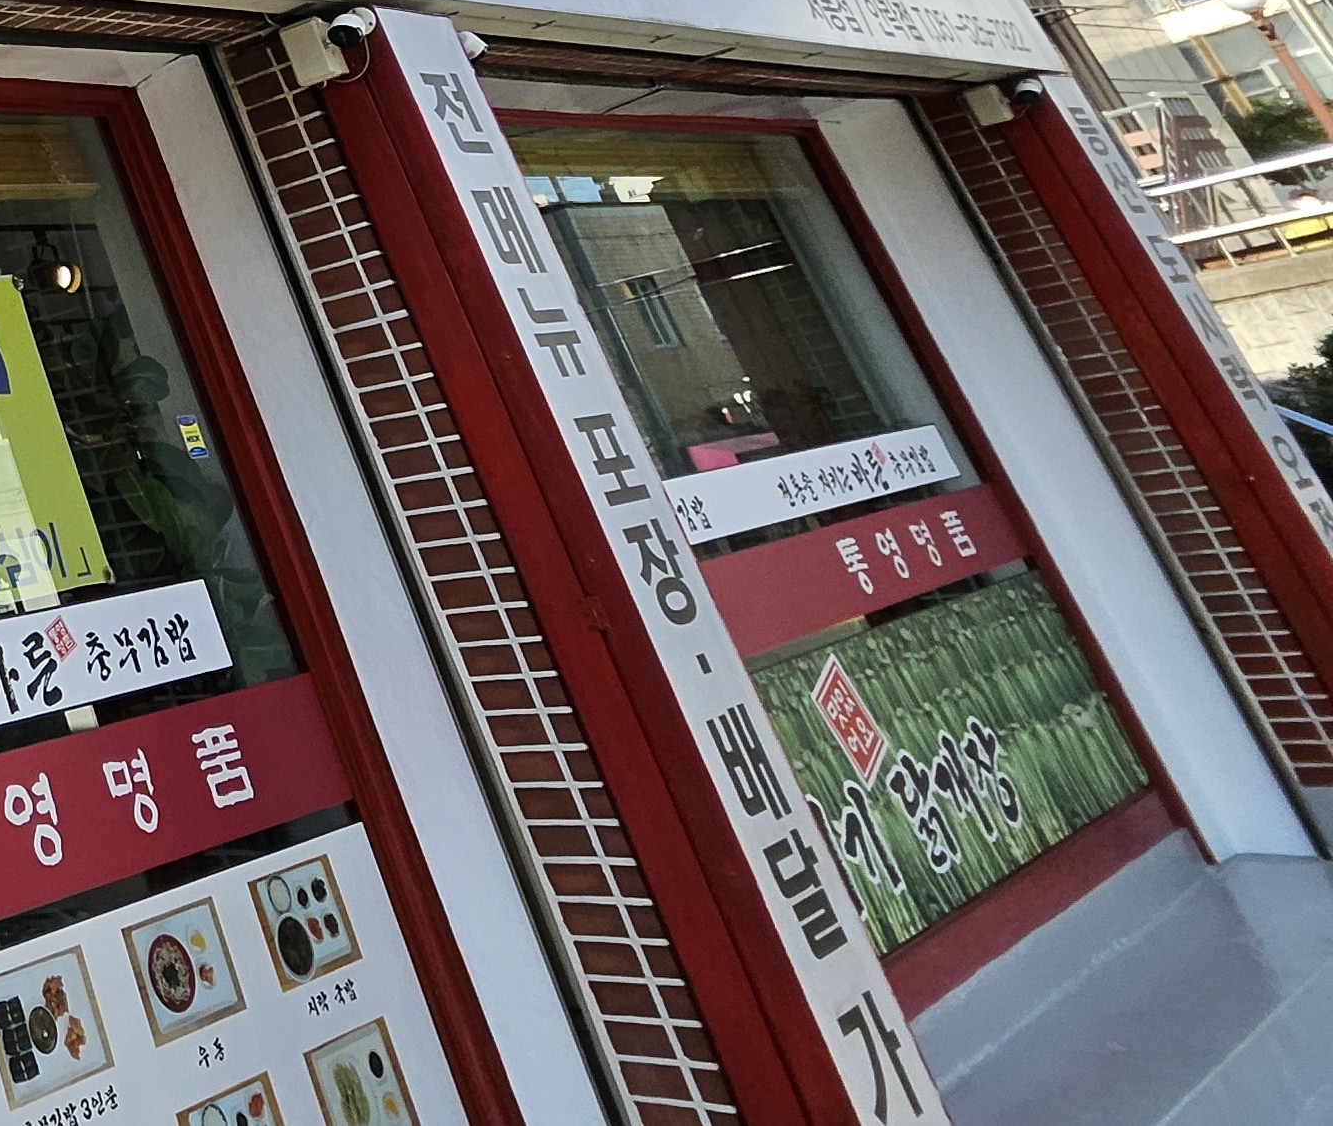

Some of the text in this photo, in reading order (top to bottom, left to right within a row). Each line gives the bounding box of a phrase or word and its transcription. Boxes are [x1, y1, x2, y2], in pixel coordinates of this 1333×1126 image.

[777, 474, 819, 508] 전통을
[818, 466, 854, 497] 지키는
[851, 449, 890, 493] 바른
[888, 443, 937, 481] 충무김밥
[85, 613, 196, 681] 충무김밥
[574, 413, 698, 626] 포장
[706, 702, 849, 961] 배달
[888, 720, 1021, 868] 닭개장
[196, 1036, 226, 1069] 우동
[80, 1084, 120, 1121] 3인분
